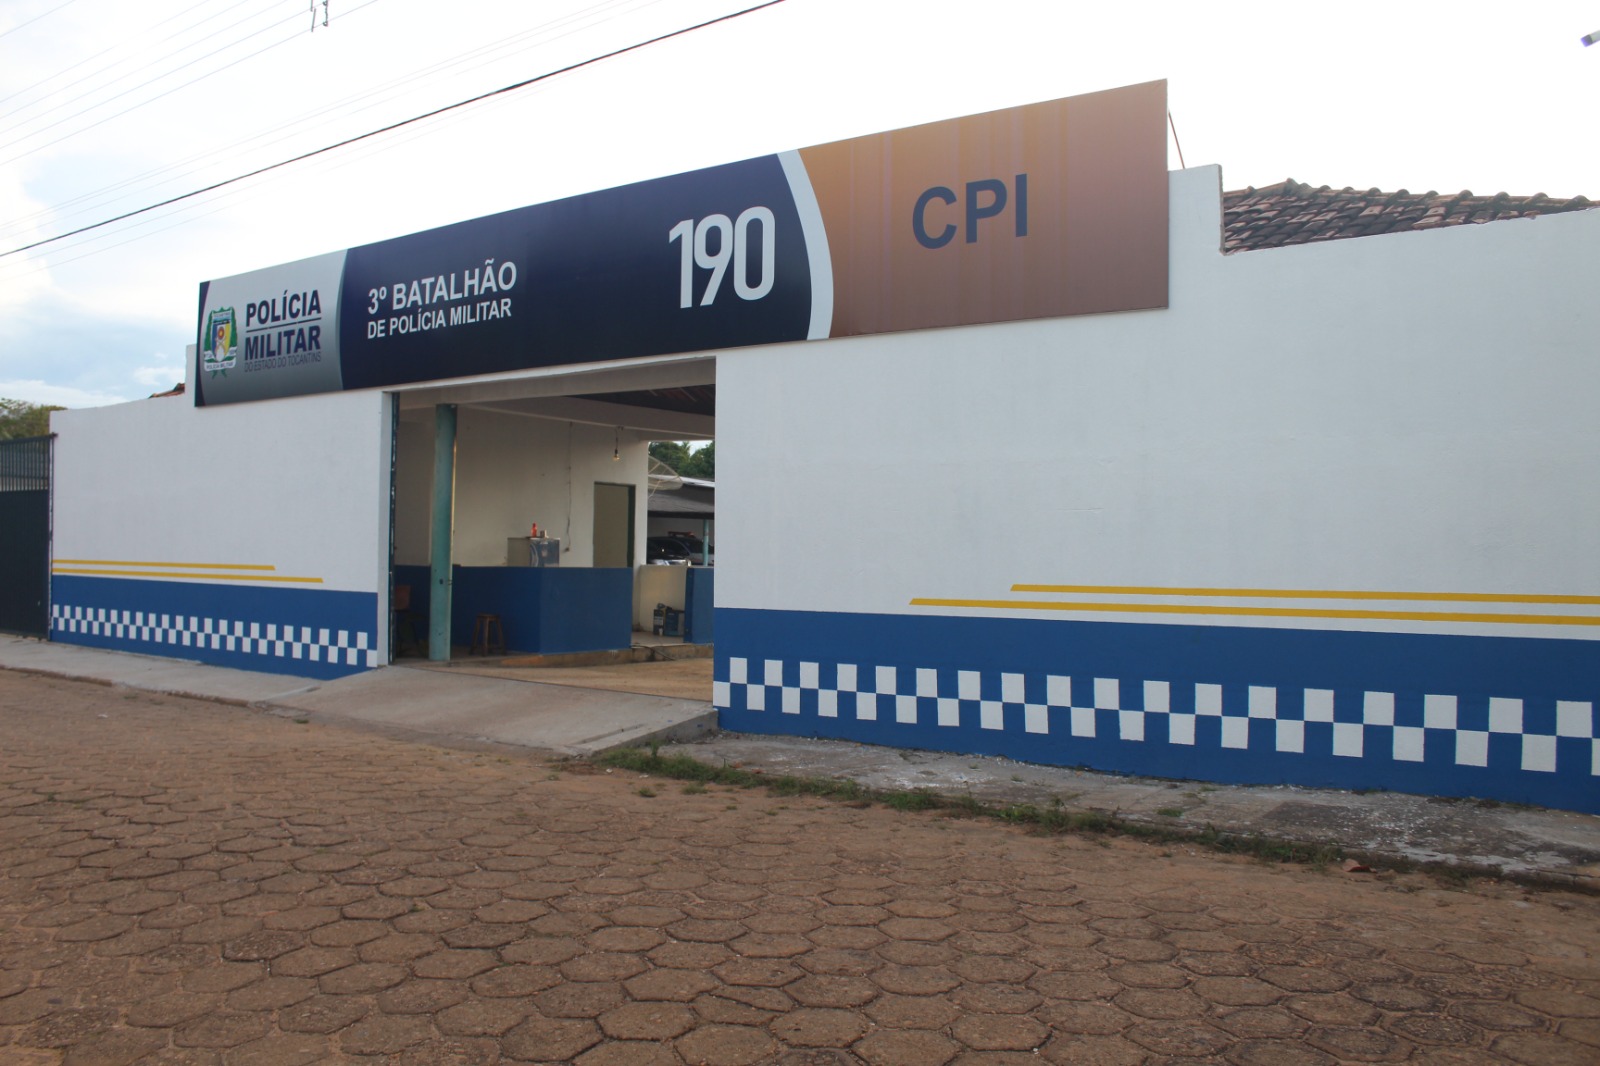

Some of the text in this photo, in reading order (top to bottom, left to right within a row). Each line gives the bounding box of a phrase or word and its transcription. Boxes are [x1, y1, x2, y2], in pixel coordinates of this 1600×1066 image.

[912, 173, 1028, 249] CPI
[669, 206, 776, 309] 190
[392, 258, 517, 310] BATALHÃO
[246, 289, 321, 327] POLÍCIA
[367, 298, 512, 339] DE POLÍCIA MILITAR
[245, 325, 321, 360] MILITAR
[254, 357, 276, 371] ESTADO
[277, 356, 287, 368] DO
[288, 351, 322, 366] TOCANTINS
